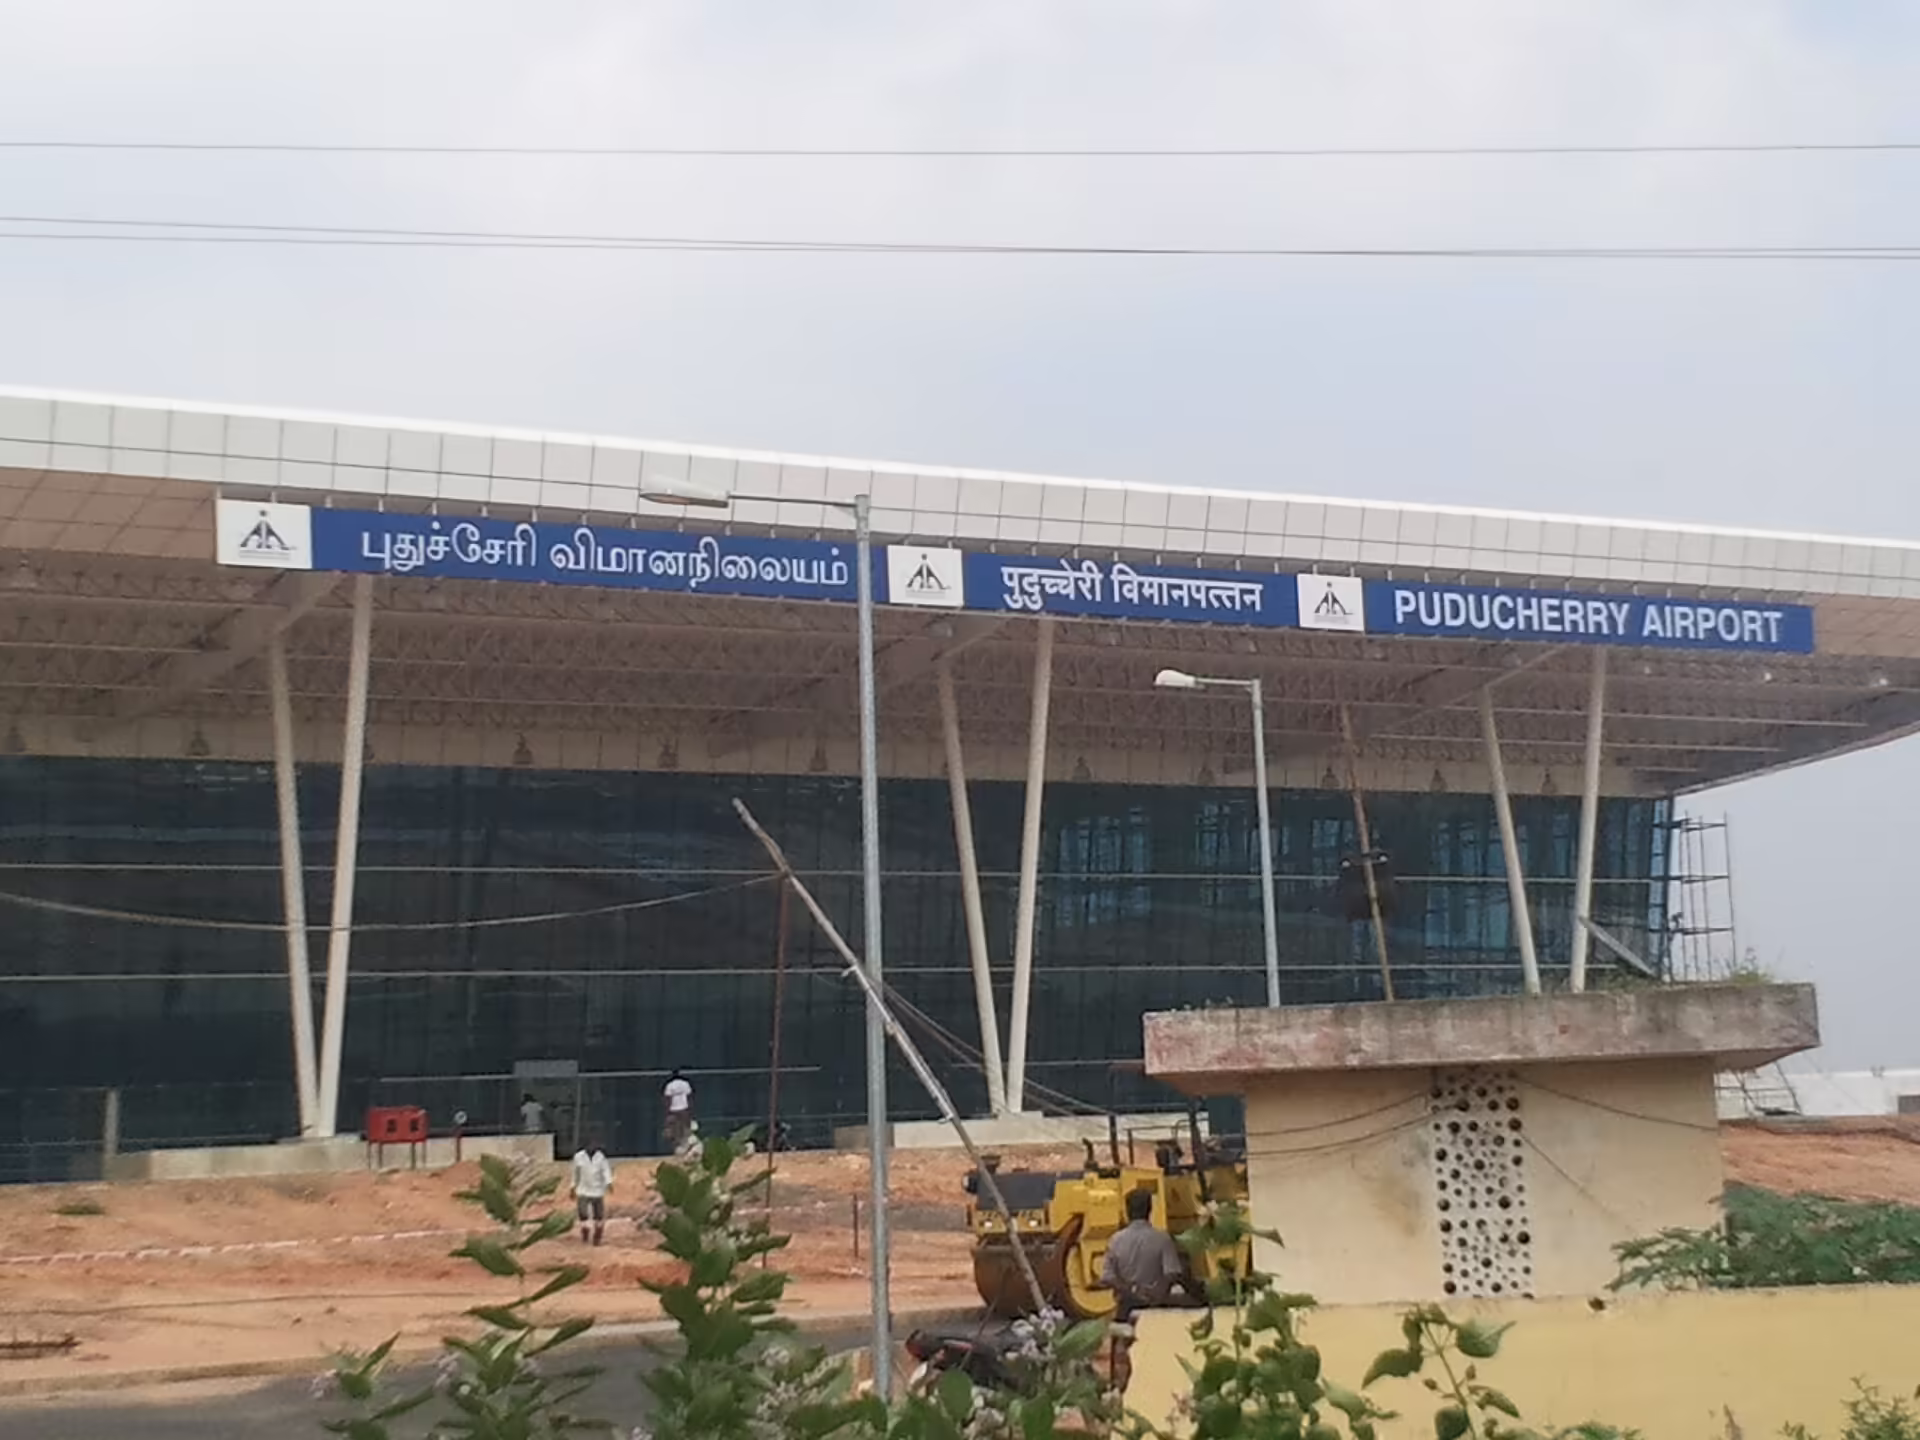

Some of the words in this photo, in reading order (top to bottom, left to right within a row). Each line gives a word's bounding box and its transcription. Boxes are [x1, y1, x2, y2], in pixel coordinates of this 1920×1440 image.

[362, 521, 537, 572] புதுச்சேரி
[550, 527, 849, 588] விமானநிலையம்
[1000, 558, 1104, 611] पुदुच्चेरी
[1110, 562, 1263, 612] विमानपत्तन
[1395, 590, 1630, 636] PUDUCHERRY
[1642, 604, 1783, 643] AIRPORT
